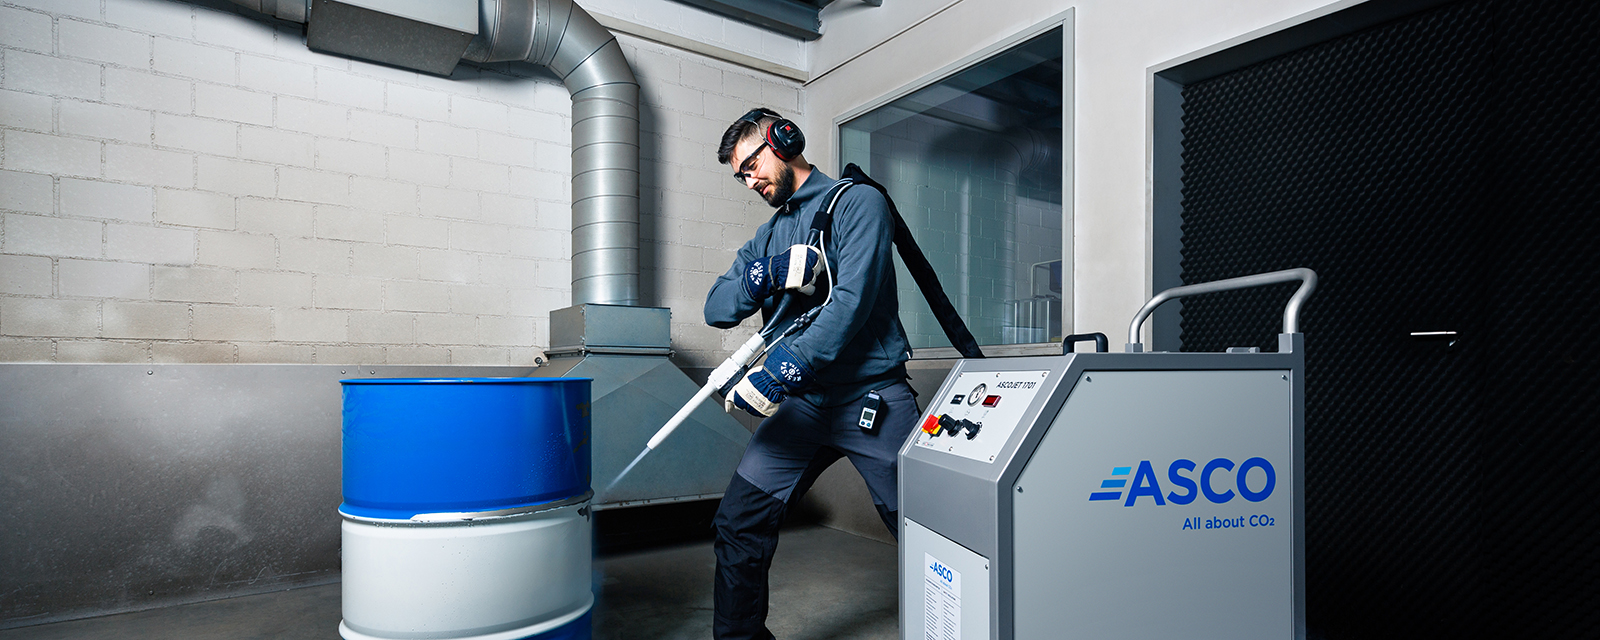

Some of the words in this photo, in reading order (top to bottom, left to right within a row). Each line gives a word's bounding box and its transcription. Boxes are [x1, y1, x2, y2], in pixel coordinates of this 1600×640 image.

[996, 381, 1023, 389] ASCOJET
[1022, 381, 1037, 389] 1701
[1123, 456, 1277, 508] ASCO
[1182, 516, 1201, 531] All
[1205, 515, 1245, 530] about
[933, 561, 953, 583] ASCO
